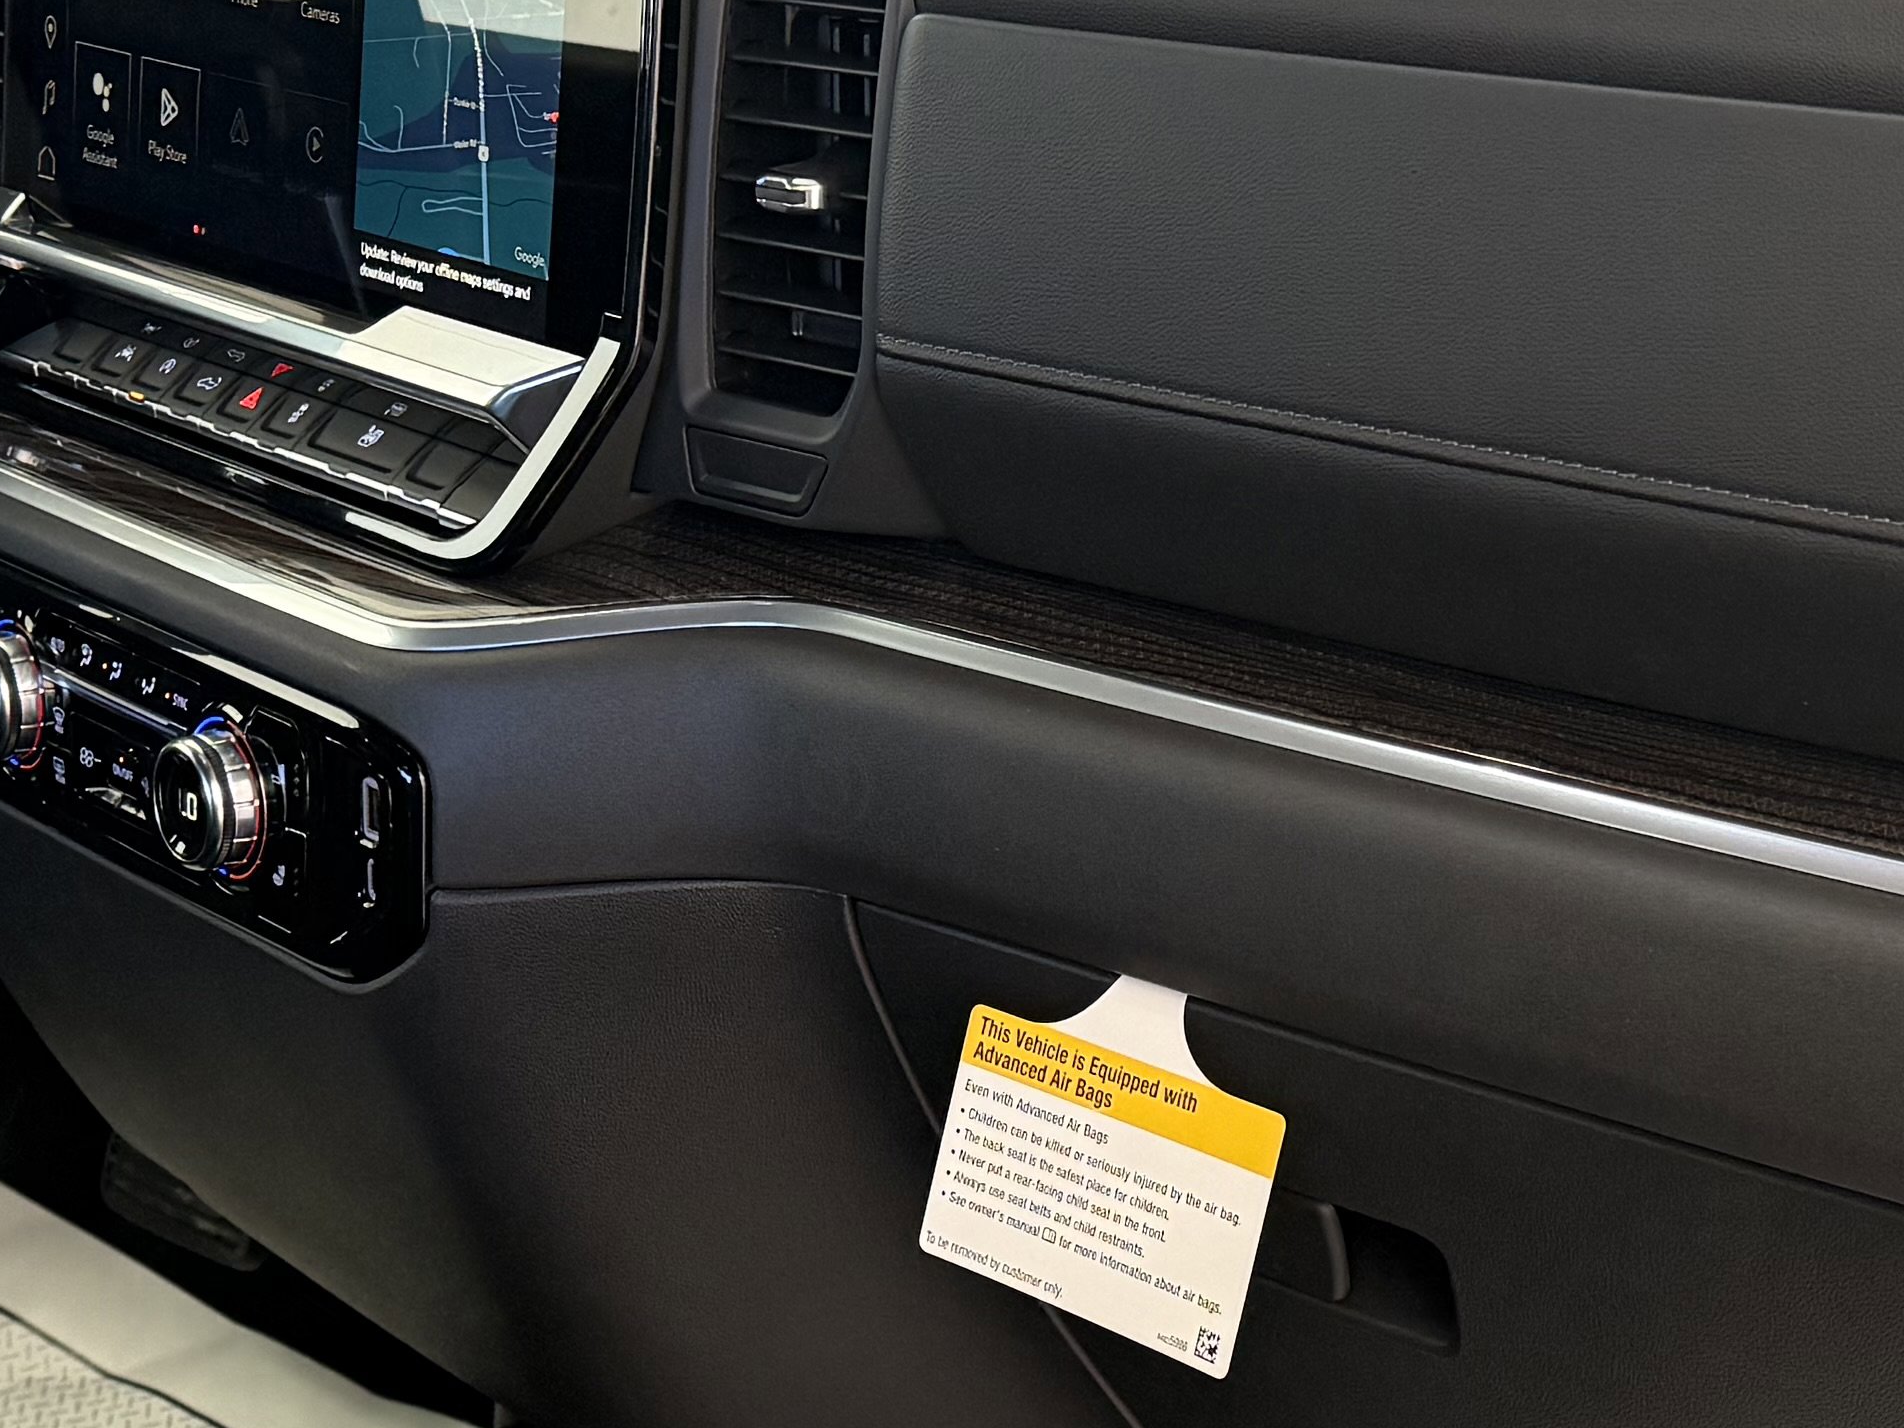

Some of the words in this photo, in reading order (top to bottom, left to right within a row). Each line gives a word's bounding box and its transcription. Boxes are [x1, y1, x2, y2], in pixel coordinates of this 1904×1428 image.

[300, 1, 341, 24] Cameras
[514, 246, 545, 269] Google
[514, 286, 531, 301] and
[972, 1041, 1048, 1083] Advanced
[1048, 1068, 1072, 1092] Air
[1074, 1077, 1112, 1108] Bags
[980, 1015, 1011, 1043] This
[1016, 1028, 1068, 1064] Vehicle
[1071, 1048, 1085, 1070] is
[1088, 1055, 1160, 1098] Equipped
[1163, 1086, 1197, 1113] with
[964, 1078, 989, 1097] Even
[992, 1090, 1013, 1107] with
[1015, 1097, 1065, 1127] Advanced
[1065, 1117, 1081, 1133] Air
[1083, 1123, 1109, 1144] Bags
[964, 1127, 980, 1144] The
[982, 1135, 1005, 1154] back
[1006, 1147, 1027, 1163] seat
[1039, 1158, 1054, 1173] the
[1055, 1166, 1084, 1186] safest
[1085, 1178, 1111, 1196] place
[1113, 1187, 1127, 1202] for
[968, 1107, 1007, 1132] Children
[1010, 1125, 1028, 1140] can
[1086, 1155, 1130, 1183] seriously
[1133, 1171, 1168, 1195] injured
[1170, 1185, 1182, 1203] by
[1185, 1192, 1201, 1208] the
[1203, 1202, 1218, 1215] air
[1219, 1206, 1240, 1226] bag.
[1058, 1235, 1072, 1249] for
[1073, 1243, 1097, 1260] more
[1099, 1251, 1151, 1284] information
[1153, 1276, 1180, 1297] about
[1182, 1289, 1195, 1302] air
[1197, 1293, 1221, 1314] bags.
